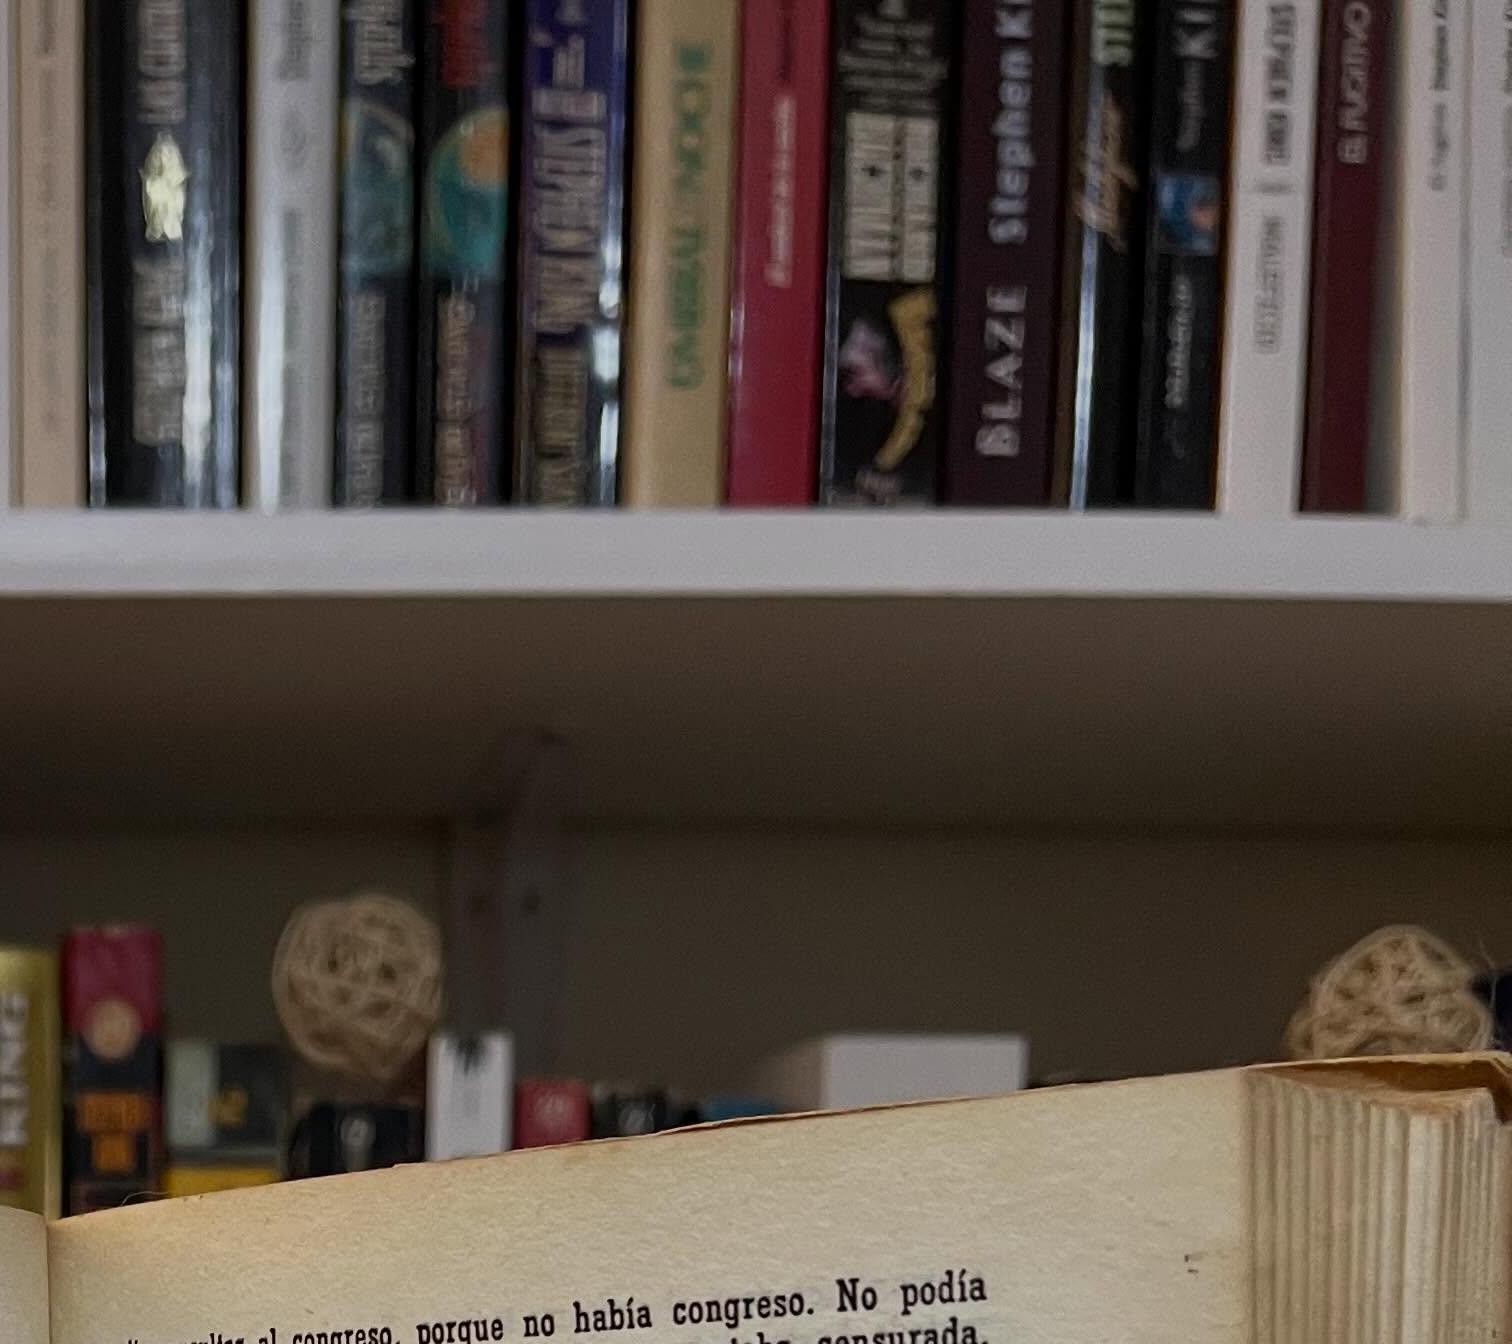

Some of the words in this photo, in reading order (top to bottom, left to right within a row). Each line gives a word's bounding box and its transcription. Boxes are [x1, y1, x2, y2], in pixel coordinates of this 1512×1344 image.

[988, 48, 1038, 245] Stephen
[975, 284, 1028, 458] BLAZE
[522, 1312, 556, 1338] no
[572, 1296, 653, 1334] había
[672, 1292, 815, 1330] congreso.
[834, 1277, 879, 1313] No
[899, 1267, 988, 1317] podía
